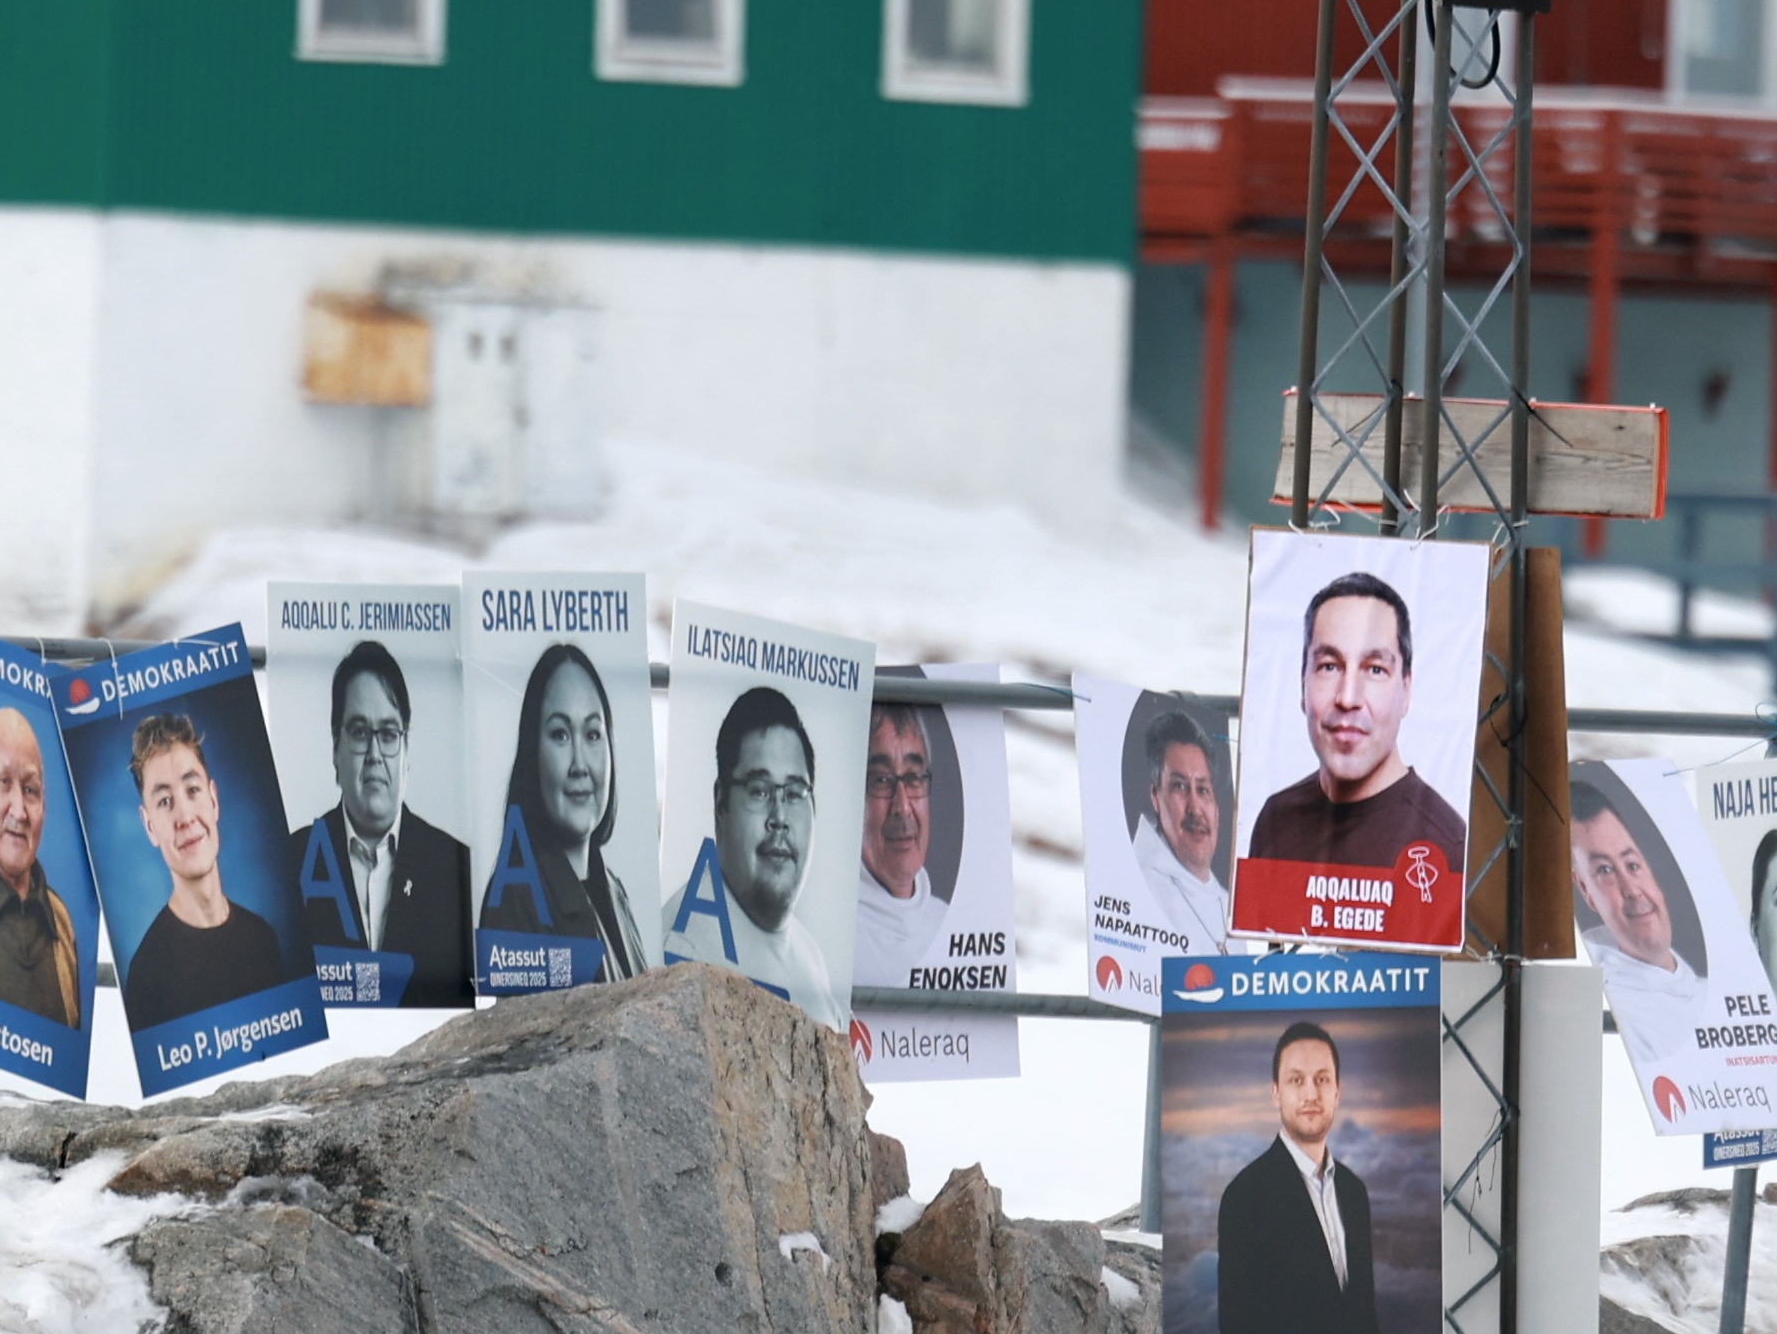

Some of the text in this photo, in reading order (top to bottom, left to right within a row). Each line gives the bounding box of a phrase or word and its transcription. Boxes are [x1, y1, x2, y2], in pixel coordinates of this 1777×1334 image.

[282, 601, 452, 633] AQQALU C. JERIMIASSEN
[481, 590, 629, 634] SARA LYBERTH
[101, 641, 240, 702] DEMOKRAATIT
[687, 624, 860, 692] ILATSIAQ MARKUSSEN
[1713, 781, 1756, 820] NAJA
[299, 818, 360, 941] A
[488, 803, 552, 927] A
[672, 837, 739, 965] A
[1094, 895, 1131, 916] JENS
[1305, 875, 1394, 906] AQQALUAQ
[1095, 913, 1189, 954] NAPAATTOOQ
[1310, 905, 1385, 933] B. EGEDE
[489, 944, 546, 970] Atassut
[948, 932, 1006, 958] HANS
[335, 985, 353, 1001] 2025
[529, 971, 547, 988] 2025
[909, 965, 1007, 990] ENOKSEN
[1231, 967, 1430, 996] DEMOKRAATIT
[1724, 994, 1771, 1018] PELE
[157, 1004, 304, 1071] Leo P. Jørgensen
[881, 1028, 970, 1063] Naleraq
[1688, 1081, 1772, 1113] Naleraq
[1745, 1141, 1760, 1157] 2025
